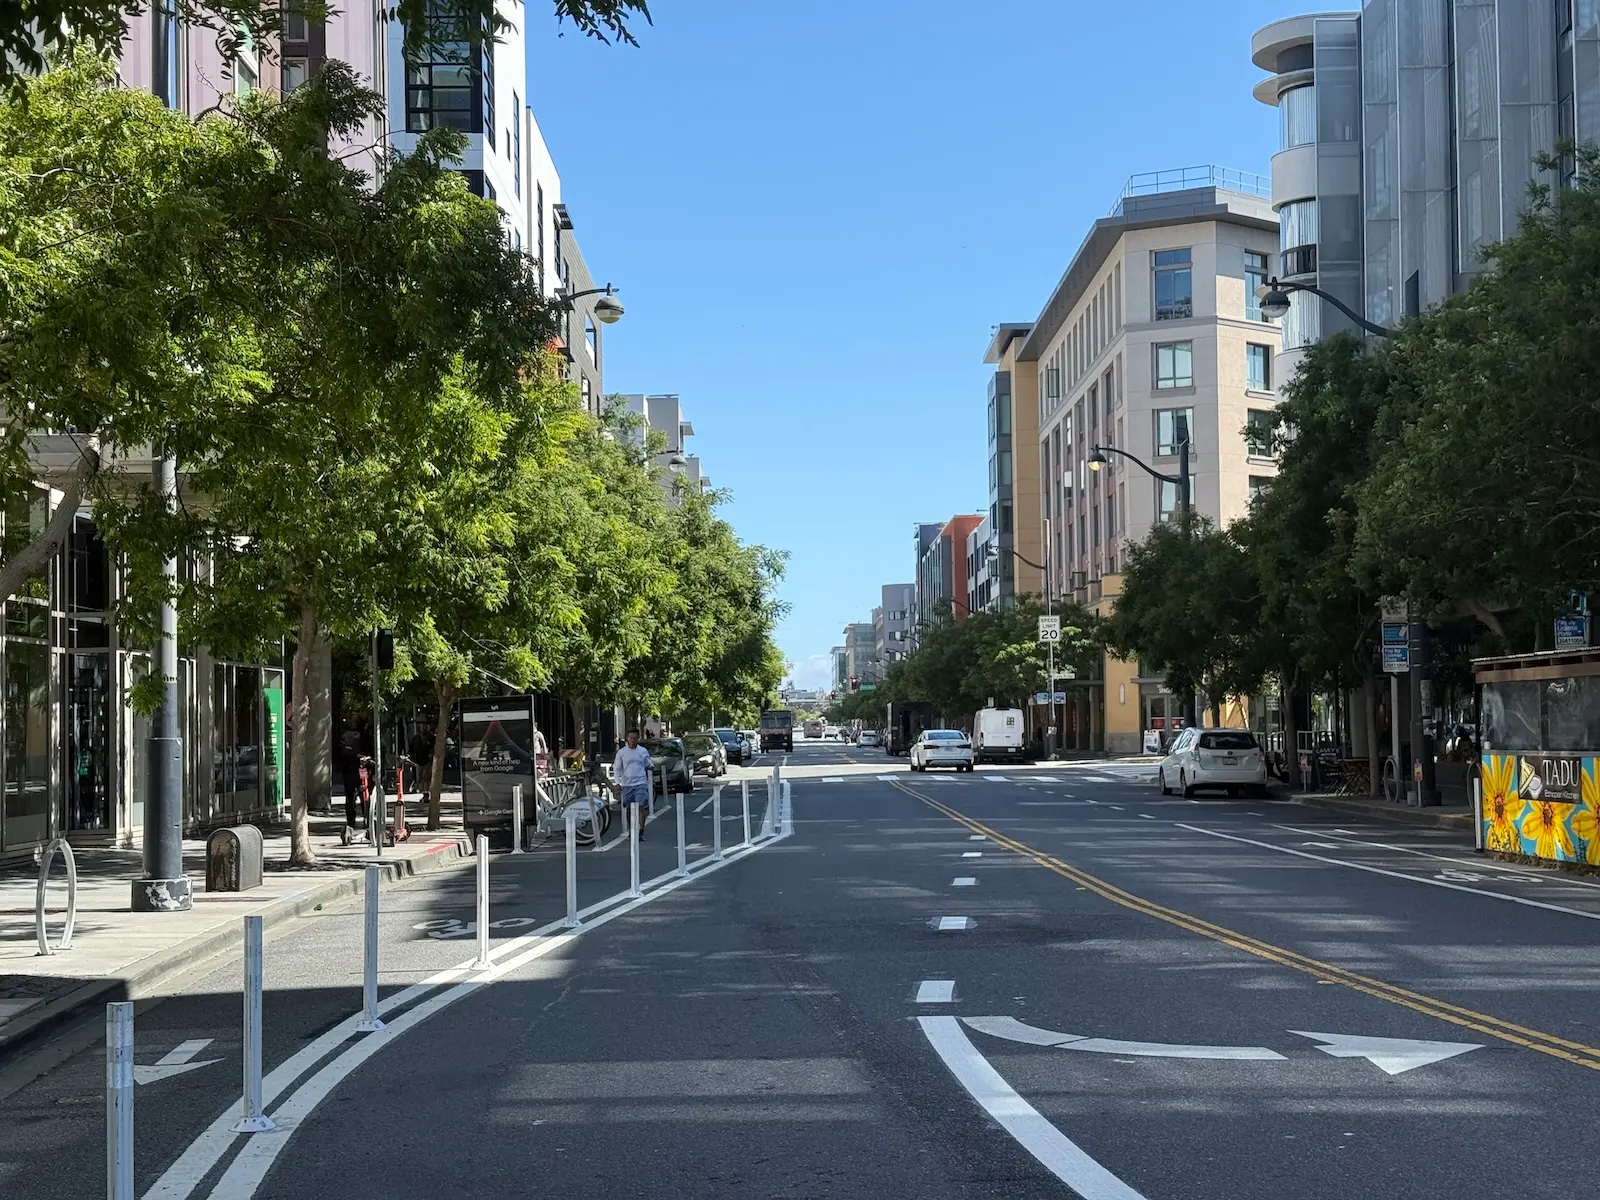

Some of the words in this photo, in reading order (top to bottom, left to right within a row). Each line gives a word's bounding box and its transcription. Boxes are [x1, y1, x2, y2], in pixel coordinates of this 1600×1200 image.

[1041, 629, 1058, 640] 20
[494, 764, 515, 772] Google
[1542, 759, 1580, 787] TADU
[484, 808, 502, 816] Google
